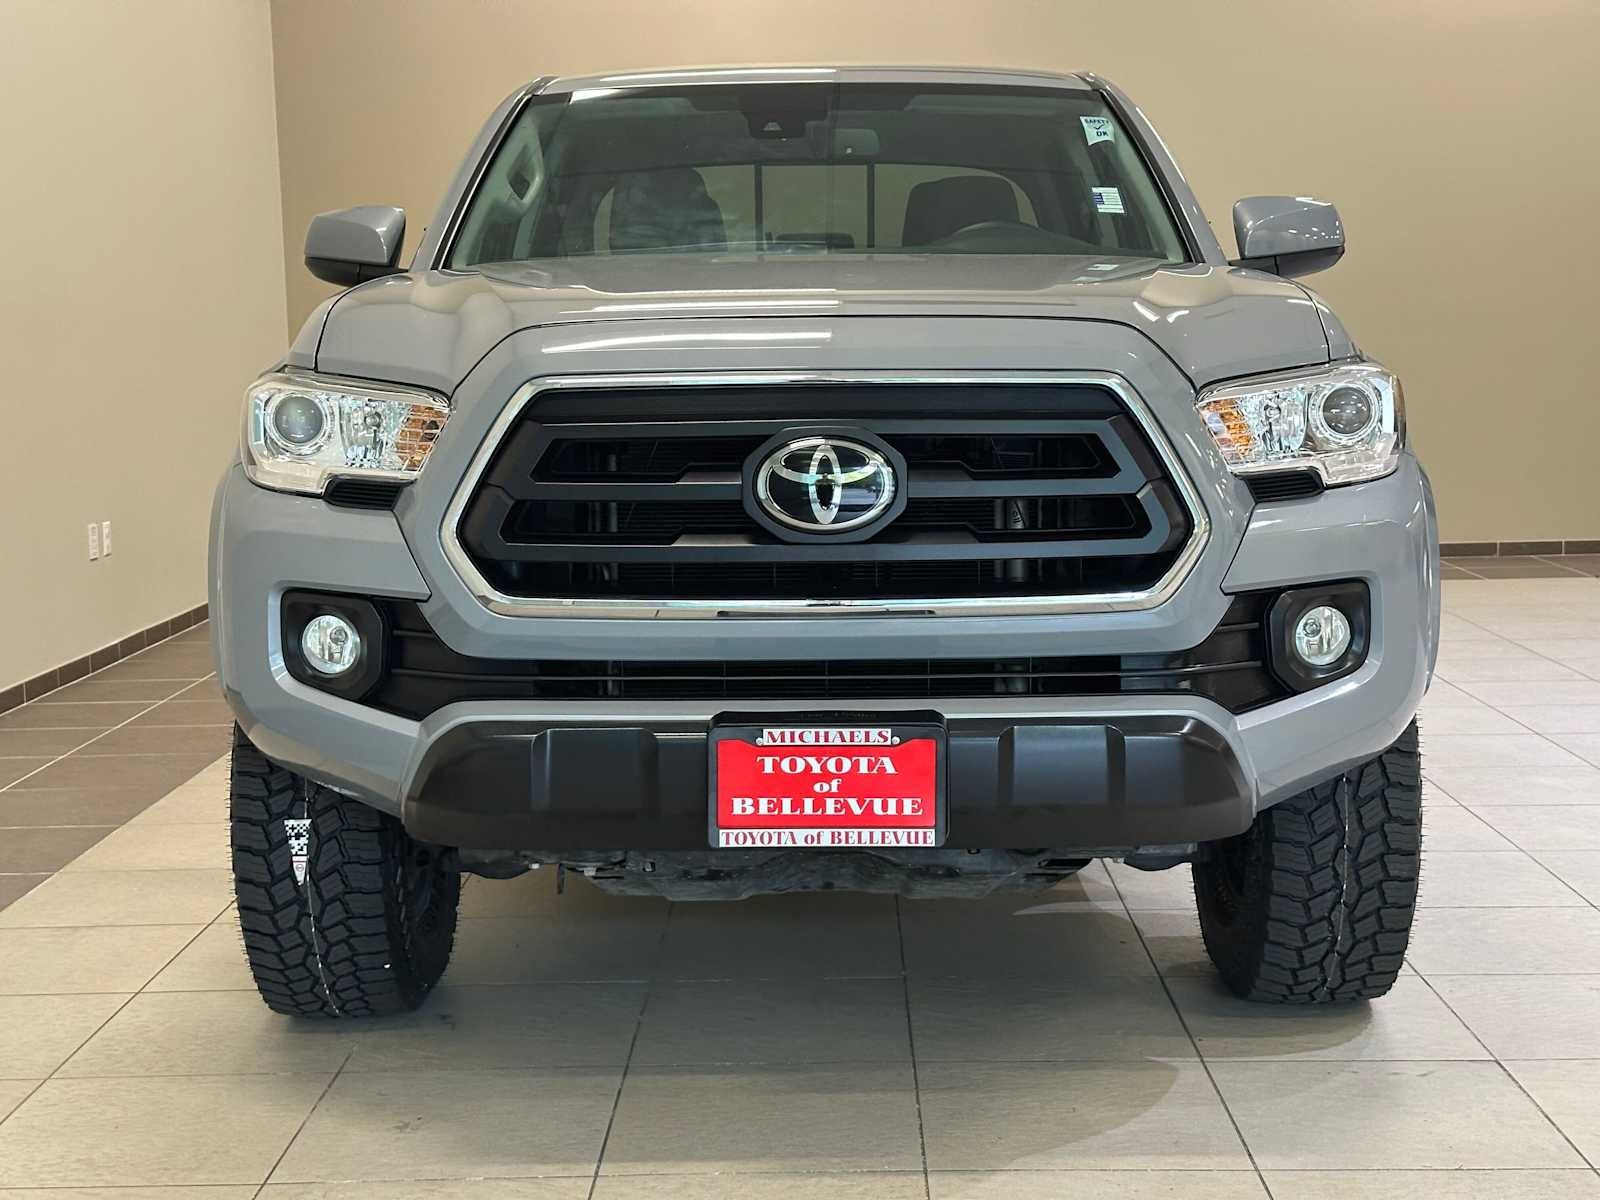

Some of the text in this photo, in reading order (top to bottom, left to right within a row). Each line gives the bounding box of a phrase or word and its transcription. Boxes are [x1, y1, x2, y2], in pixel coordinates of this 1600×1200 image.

[766, 730, 889, 743] MICHAELS
[757, 756, 898, 774] TOYOTA
[813, 779, 842, 793] of
[731, 798, 923, 815] BELLEVUE
[721, 831, 933, 845] TOYOTA of BELLEVUE
